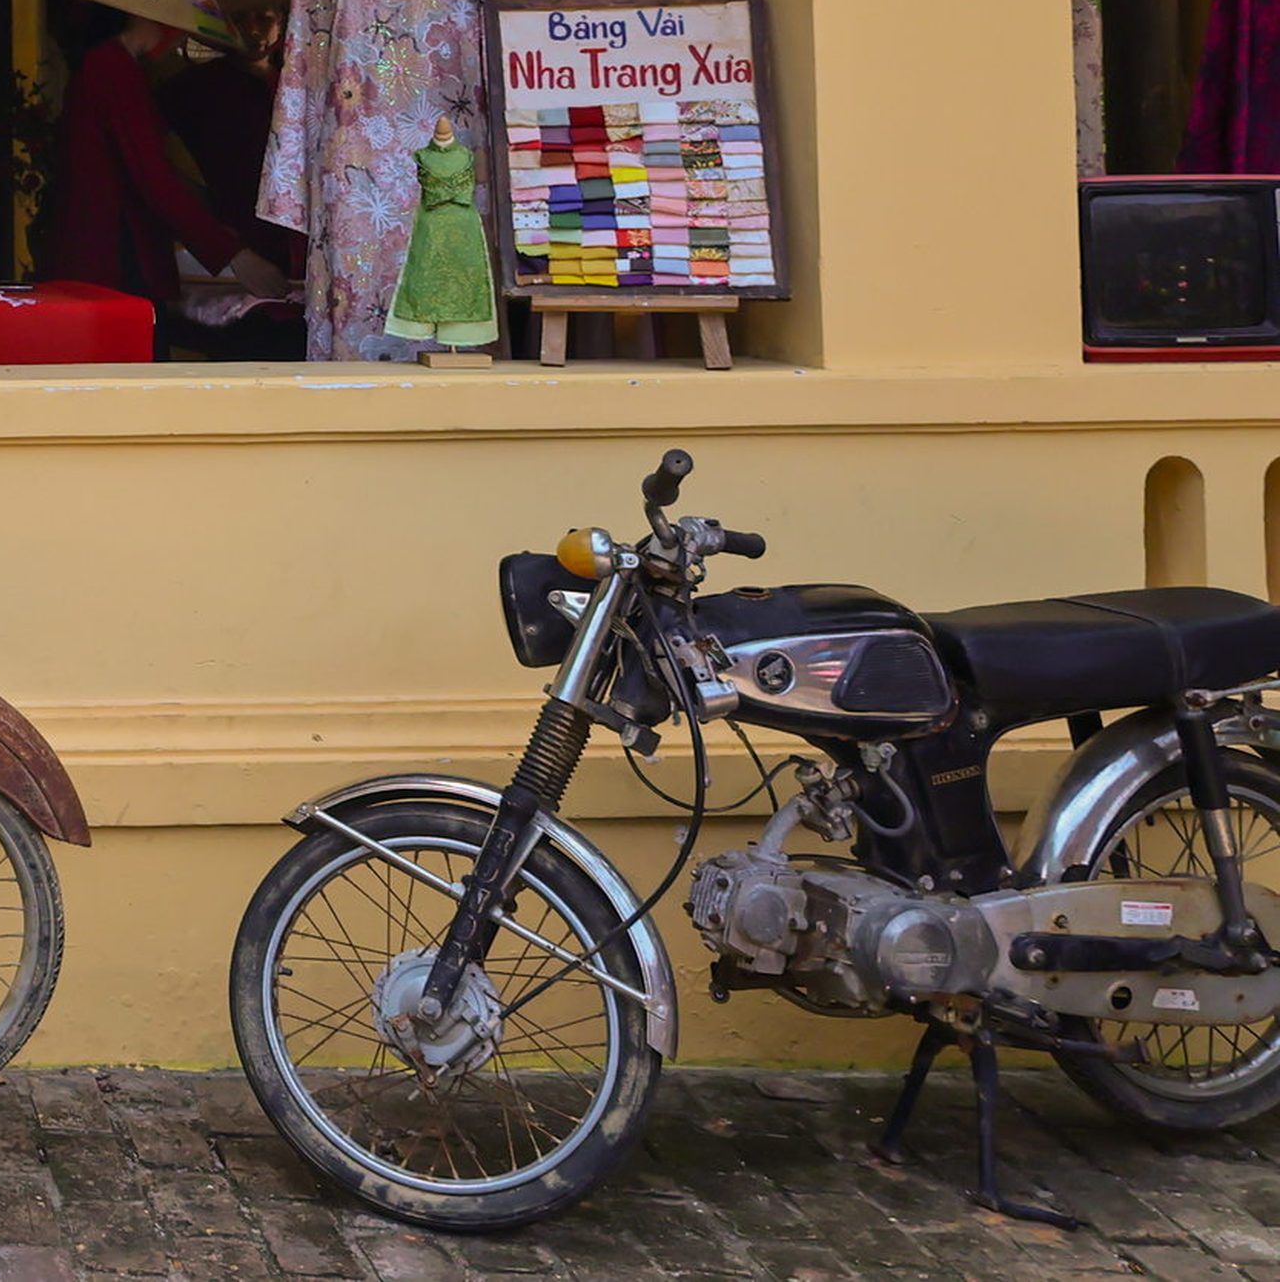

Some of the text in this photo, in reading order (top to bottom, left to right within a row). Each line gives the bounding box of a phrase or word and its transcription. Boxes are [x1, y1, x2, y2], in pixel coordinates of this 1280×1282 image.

[548, 11, 627, 49] Bảng
[509, 50, 576, 90] Nha
[580, 48, 682, 96] Trang
